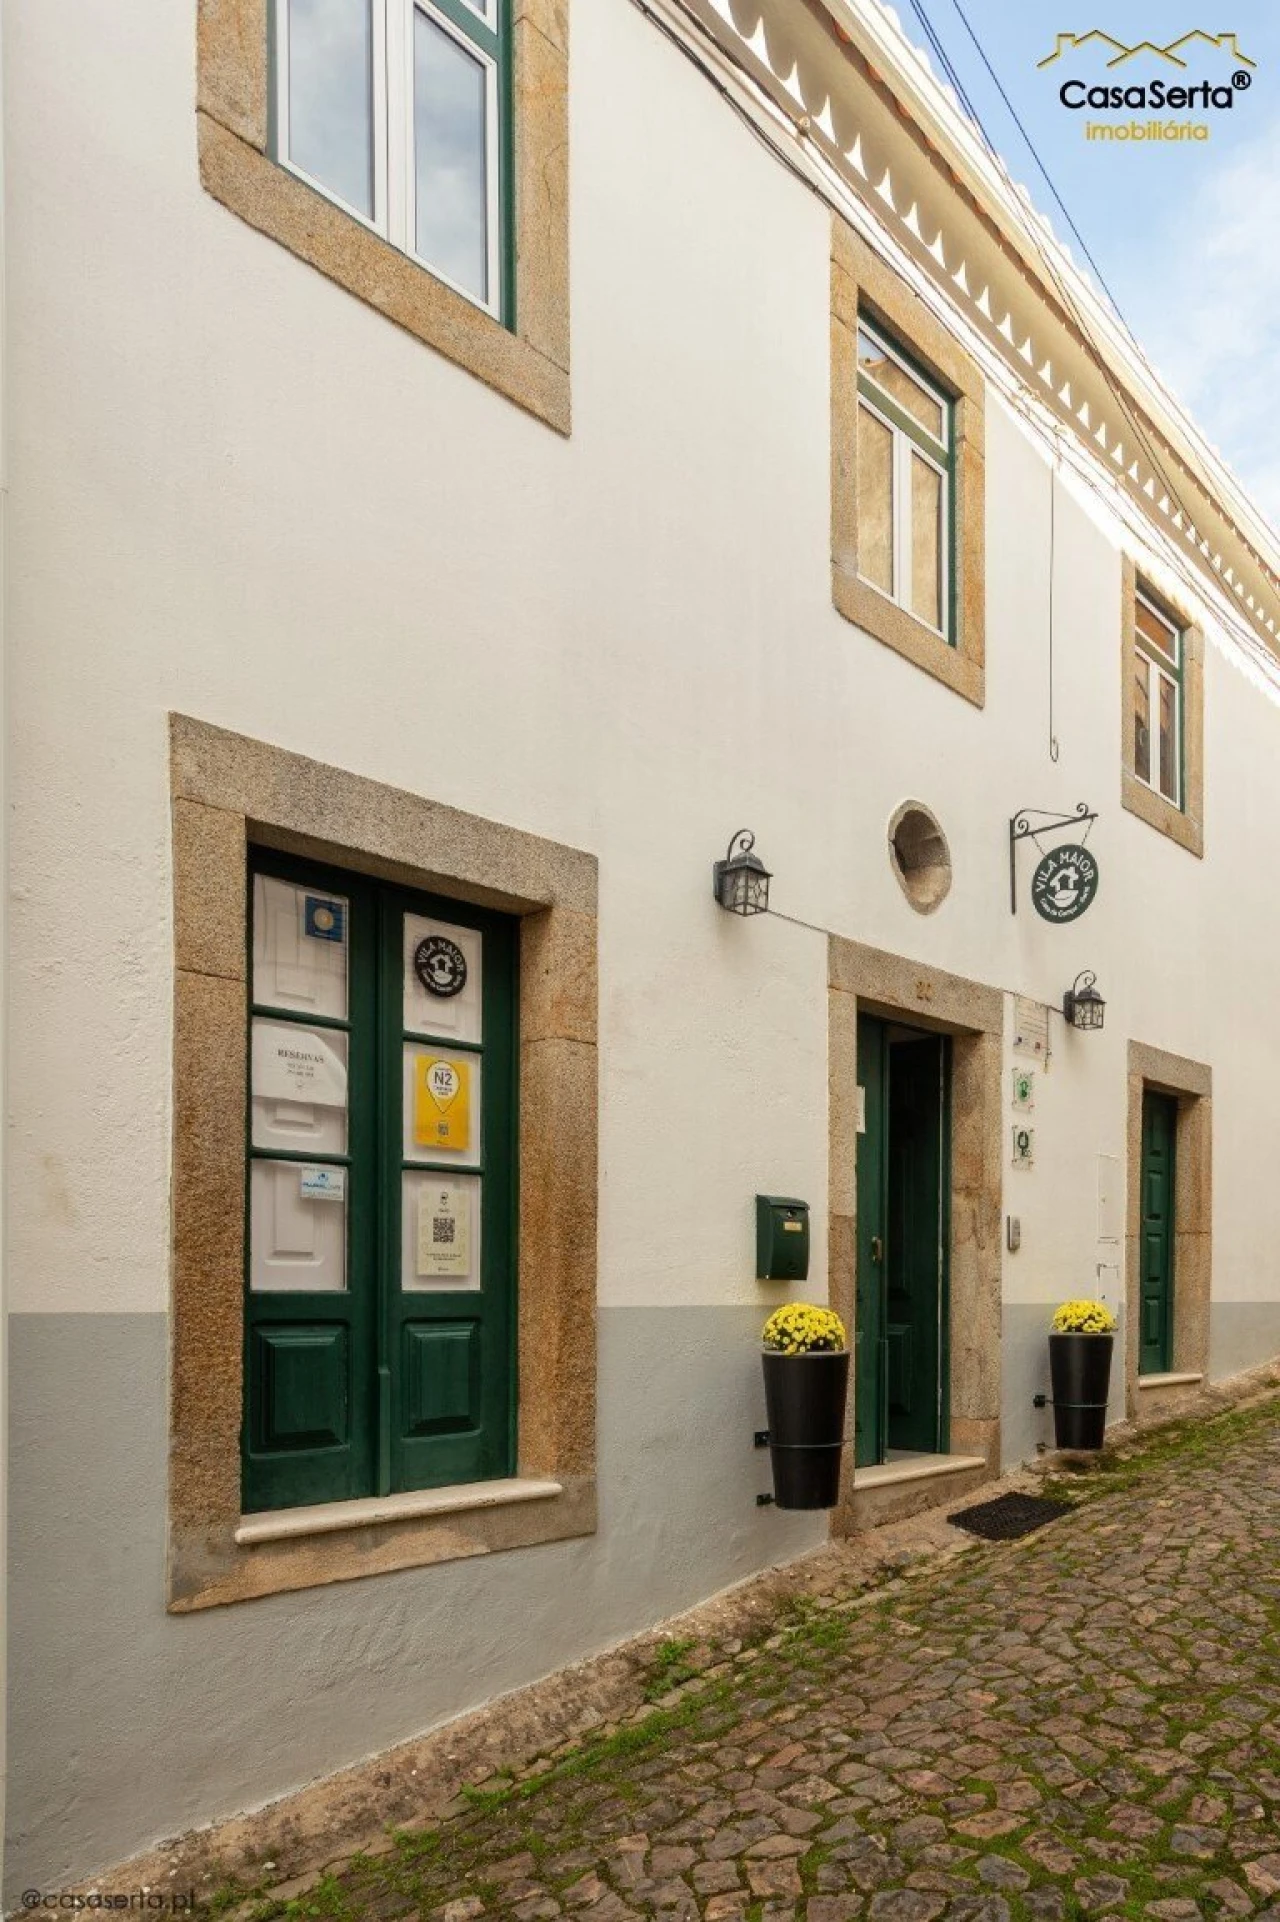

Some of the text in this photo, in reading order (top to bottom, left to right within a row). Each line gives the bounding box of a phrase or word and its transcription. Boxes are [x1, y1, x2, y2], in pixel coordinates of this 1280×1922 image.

[1035, 851, 1094, 892] VILA MAIOR
[417, 939, 464, 971] VILA MAIOR
[277, 1048, 325, 1064] RESERVAS
[434, 1071, 453, 1086] N2
